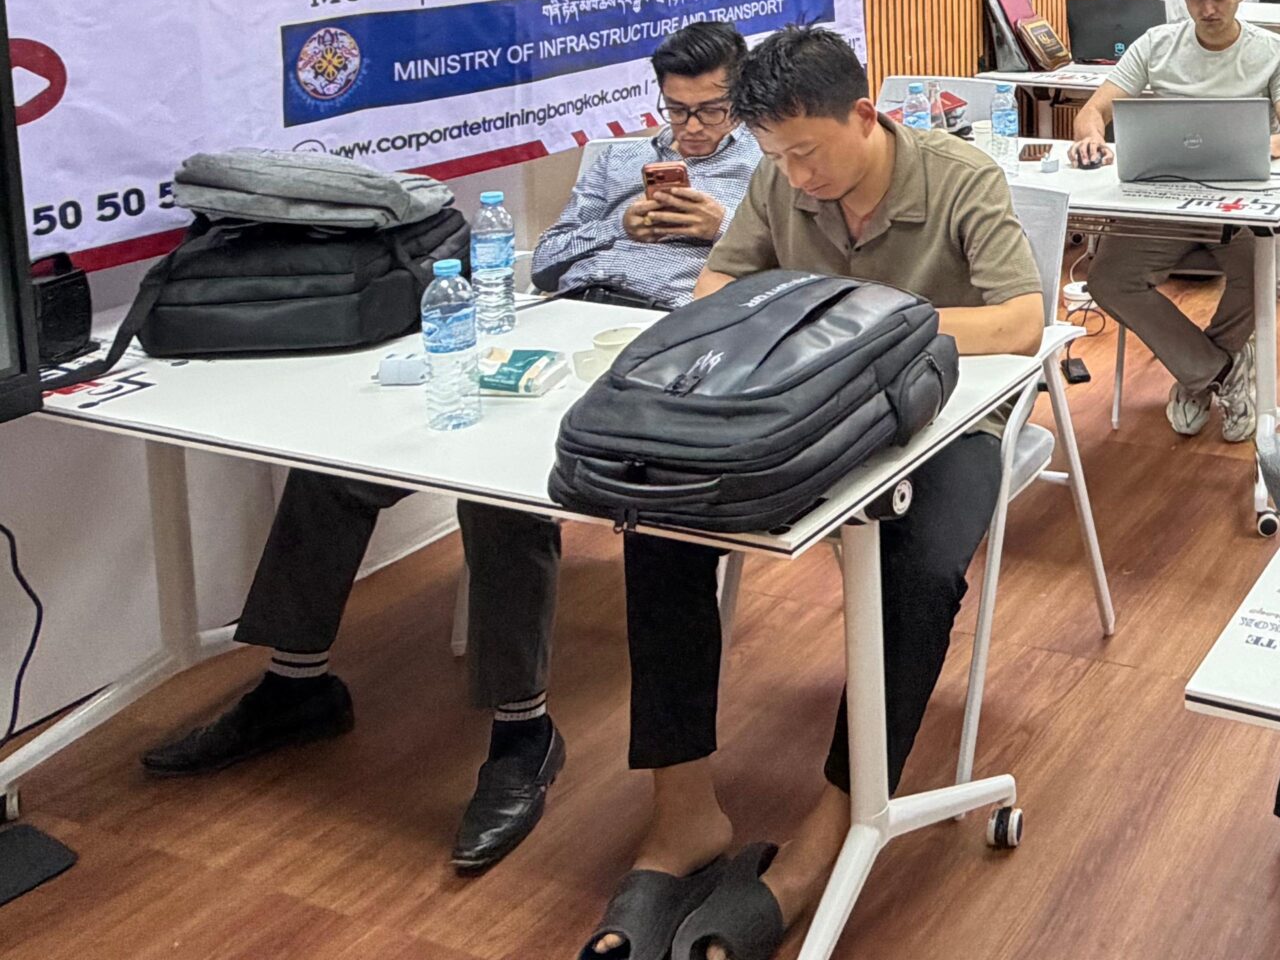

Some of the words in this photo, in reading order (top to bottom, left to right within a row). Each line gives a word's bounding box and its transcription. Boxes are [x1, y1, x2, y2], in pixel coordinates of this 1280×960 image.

[394, 47, 502, 81] MINISTRY
[507, 43, 534, 64] OF
[540, 21, 679, 59] INFRASTRUCTURE
[681, 12, 707, 30] AND
[33, 200, 82, 236] 50
[96, 188, 145, 222] 50
